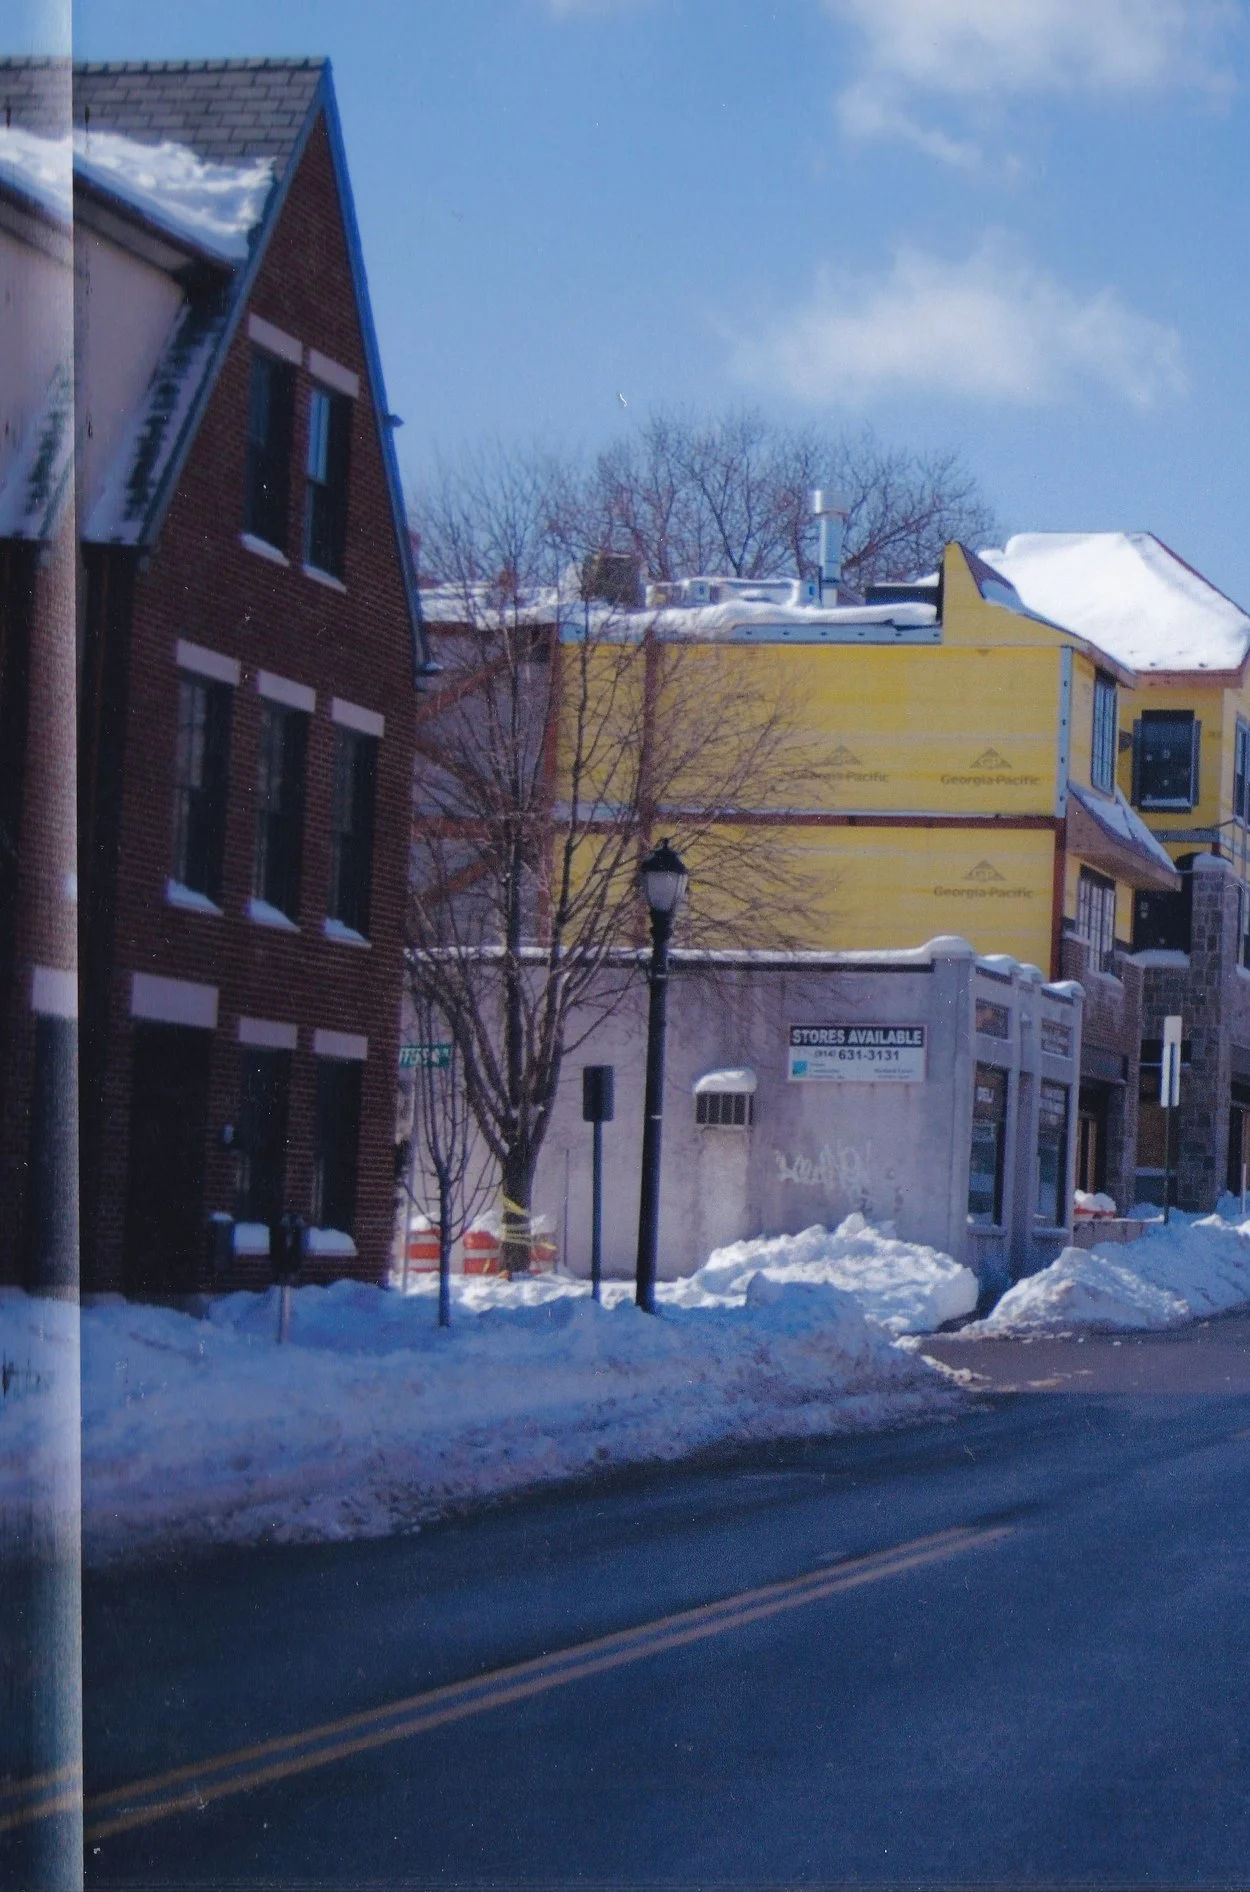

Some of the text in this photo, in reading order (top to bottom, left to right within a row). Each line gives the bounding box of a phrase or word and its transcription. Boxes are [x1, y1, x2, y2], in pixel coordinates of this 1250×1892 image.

[940, 774, 1041, 787] Georgia-Pacific
[934, 886, 1034, 899] Georgia-Pacific
[792, 1029, 922, 1045] STORES AVAILABLE
[838, 1049, 900, 1061] 631-3131
